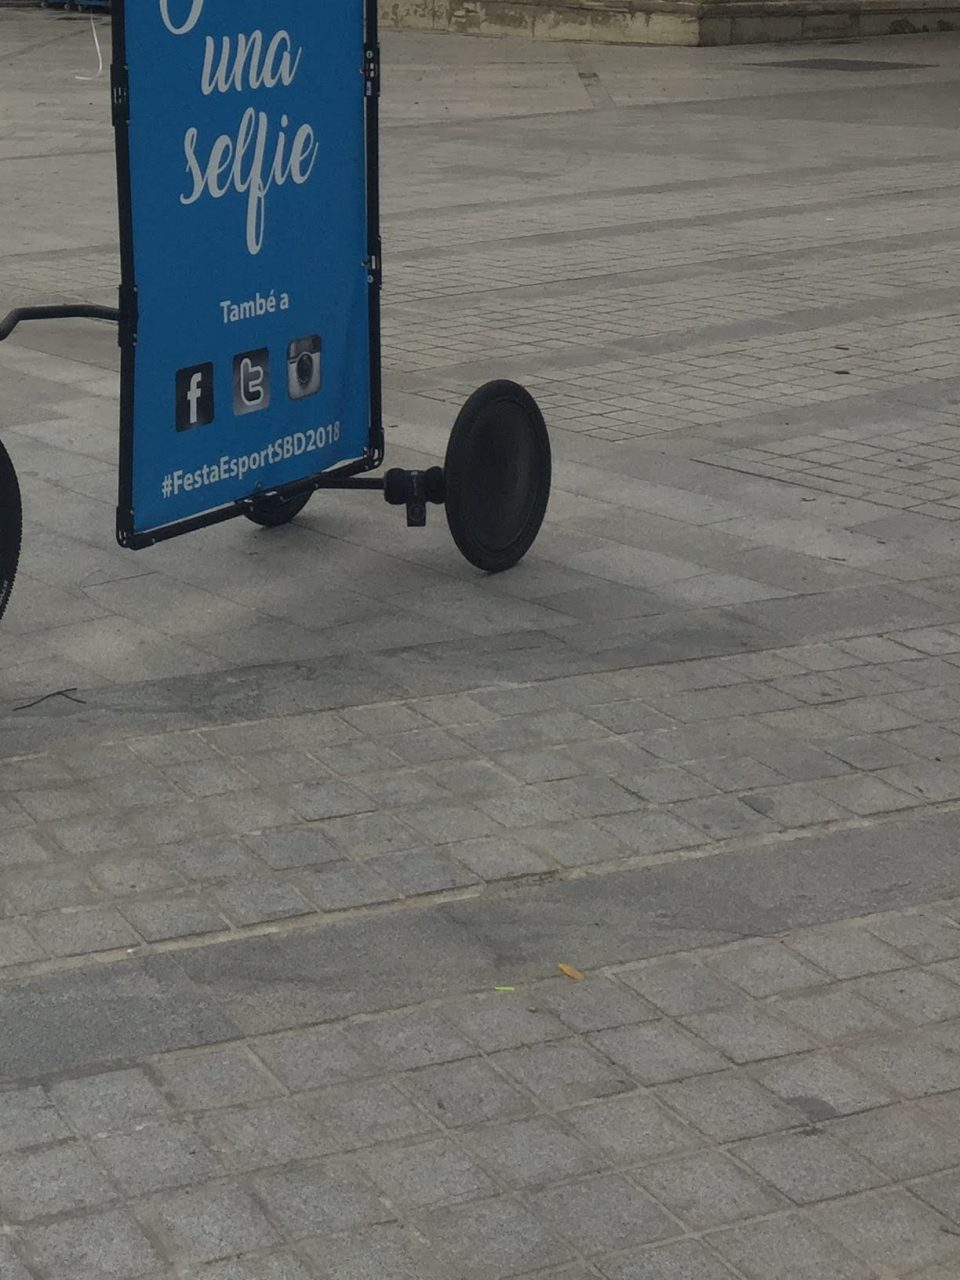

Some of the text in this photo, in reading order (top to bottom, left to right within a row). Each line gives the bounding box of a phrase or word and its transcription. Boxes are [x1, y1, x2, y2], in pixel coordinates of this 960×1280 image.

[200, 30, 302, 95] una
[179, 107, 319, 255] selfie
[220, 289, 289, 324] També a
[161, 421, 341, 498] #FestaEsportSBD2018
